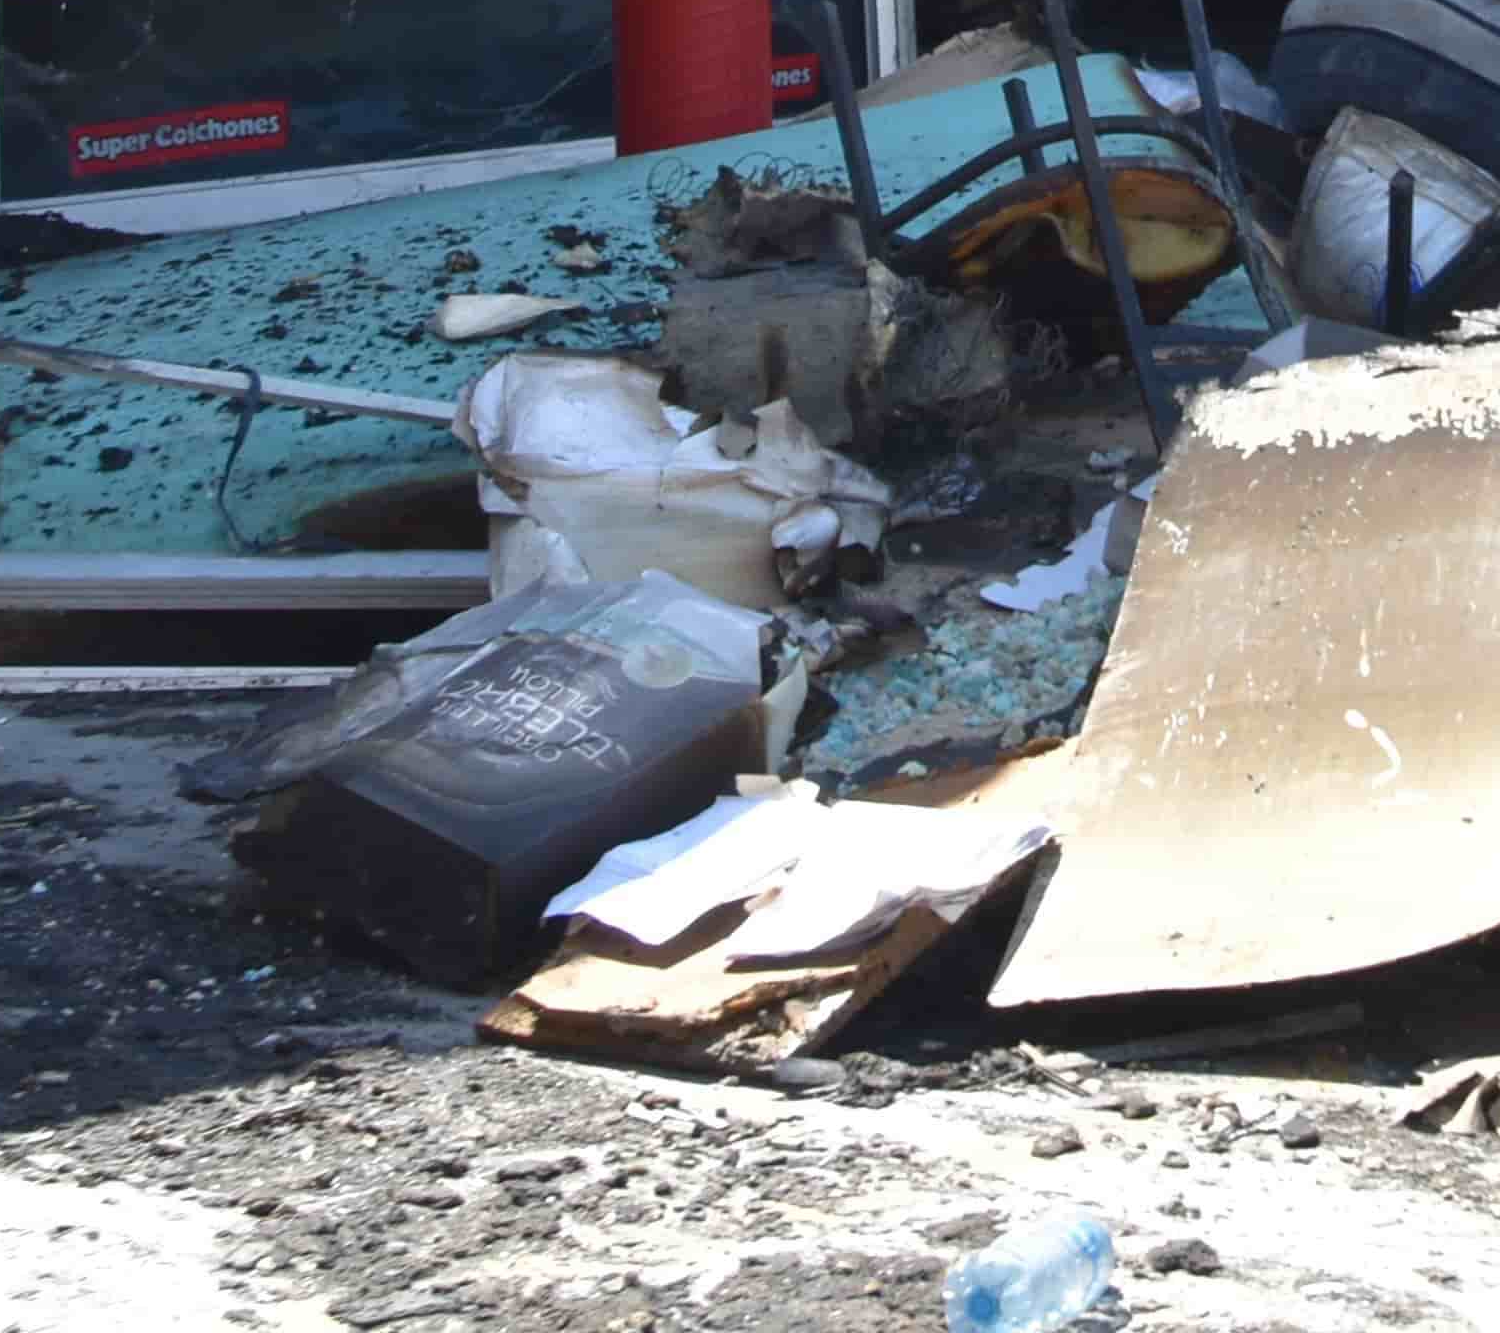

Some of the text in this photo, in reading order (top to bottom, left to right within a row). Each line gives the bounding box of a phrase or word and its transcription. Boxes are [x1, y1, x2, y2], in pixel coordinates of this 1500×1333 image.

[77, 114, 280, 162] Super Colchones
[510, 665, 604, 719] PILLOW
